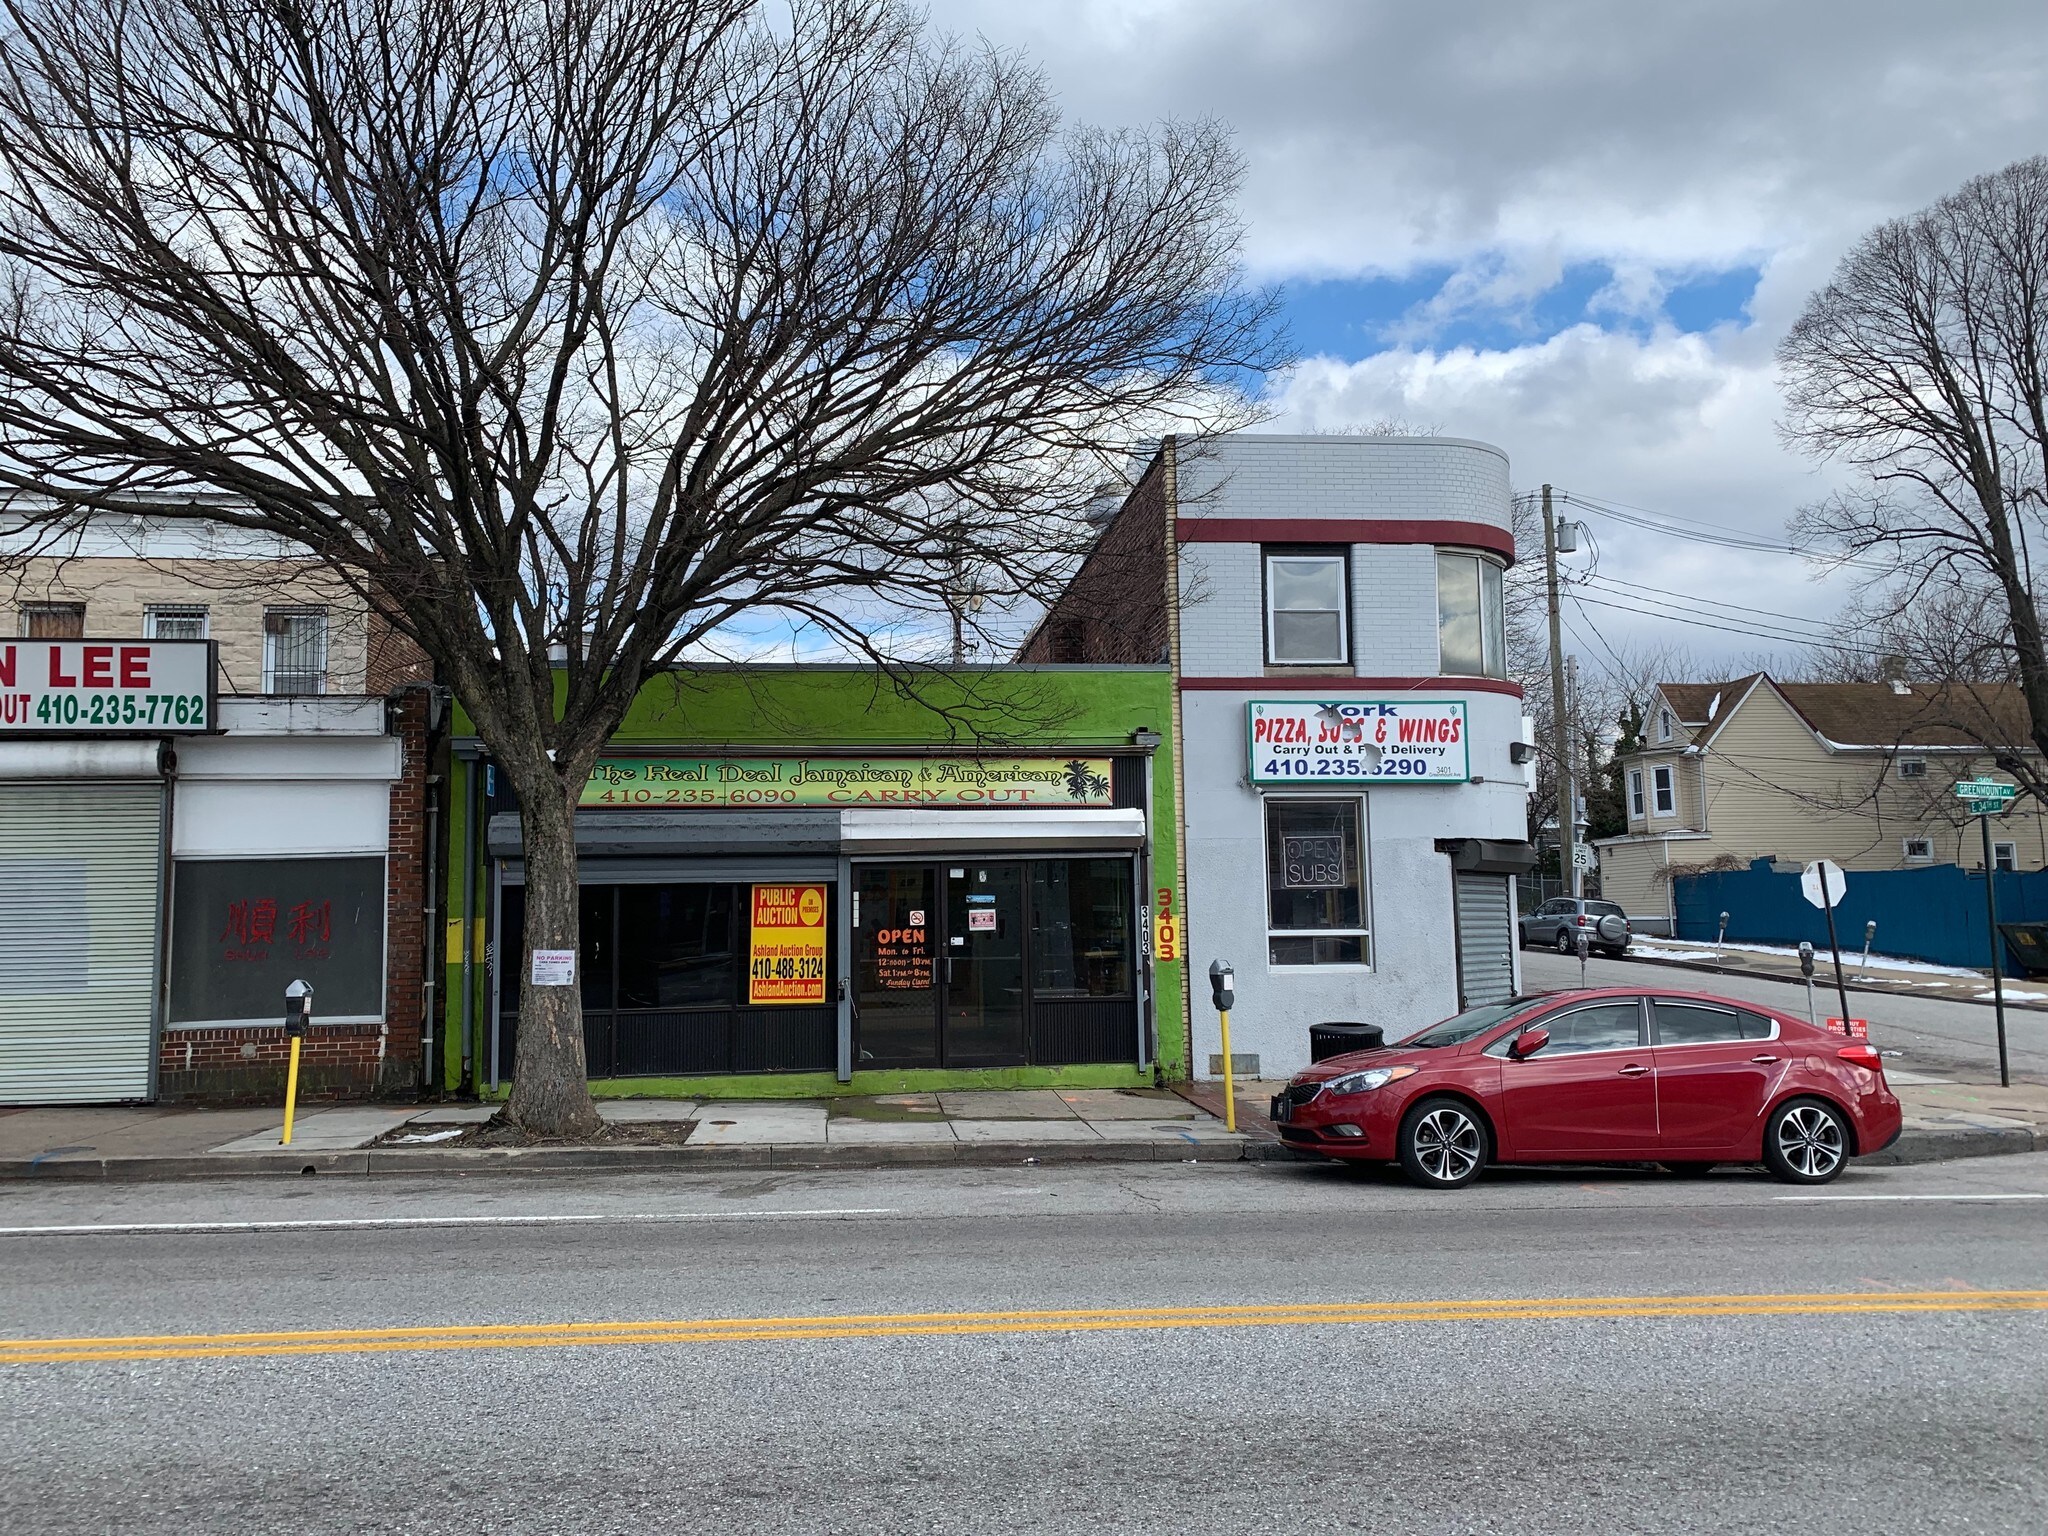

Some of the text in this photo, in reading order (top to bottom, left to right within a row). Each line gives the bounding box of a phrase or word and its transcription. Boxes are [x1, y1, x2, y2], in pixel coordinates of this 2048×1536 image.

[49, 646, 151, 688] LEE
[0, 694, 204, 725] UT 410-235-7762
[1255, 718, 1312, 746] PIZZA,
[1375, 718, 1387, 743] &
[1399, 718, 1461, 743] WINGS
[1273, 745, 1445, 757] Carry Out & Ft Delivery
[588, 760, 1063, 788] The Real Deal Jamaican & American
[1436, 766, 1451, 774] 3401
[827, 789, 947, 802] CARRY
[957, 788, 1036, 802] OUT
[1960, 784, 2003, 796] GREENMOUNT
[1287, 840, 1339, 859] OPEN
[1574, 853, 1586, 864] 25
[1288, 863, 1340, 882] SUBS
[760, 888, 796, 906] PUBLIC
[220, 898, 332, 945] 順利
[756, 906, 798, 925] AUCTION
[1157, 888, 1174, 962] 3403
[878, 928, 925, 944] OPEN
[753, 944, 823, 958] Ashland Auction Group
[878, 947, 898, 956] Mon.
[912, 947, 926, 955] Fri.
[752, 957, 823, 979] 410-488-3124
[753, 980, 822, 997] AshlandAuction.com
[886, 979, 910, 988] Sunday
